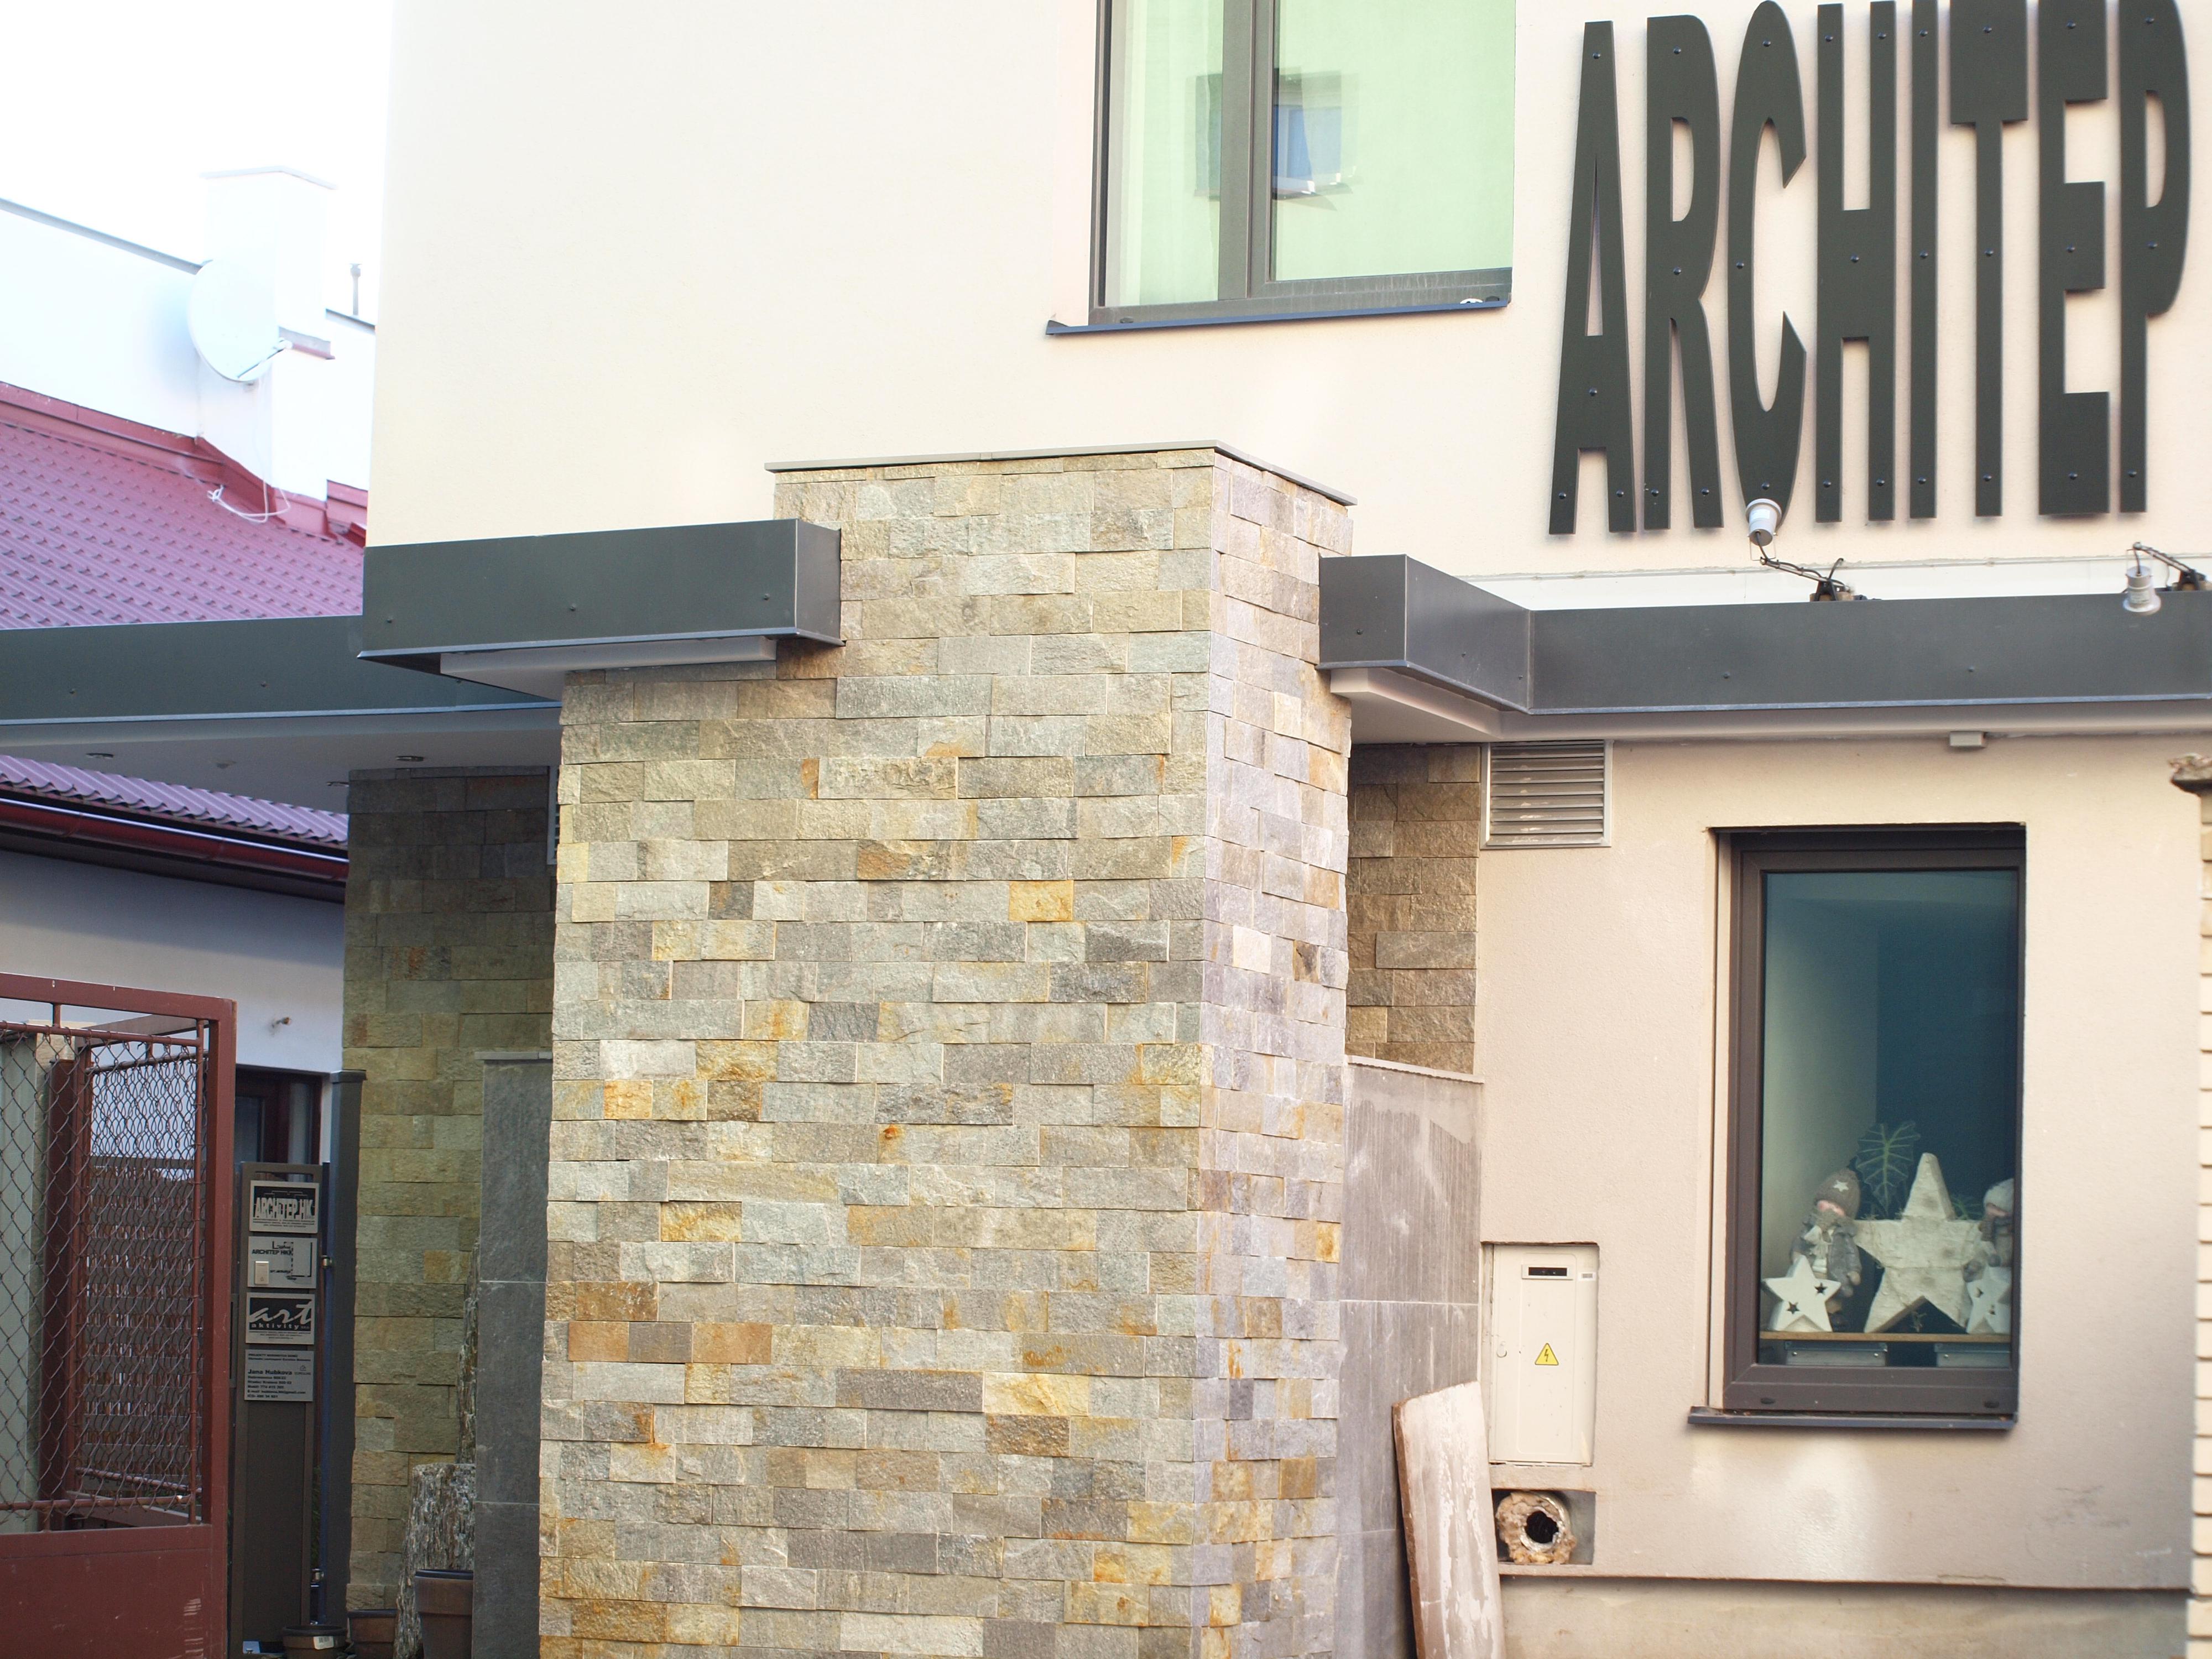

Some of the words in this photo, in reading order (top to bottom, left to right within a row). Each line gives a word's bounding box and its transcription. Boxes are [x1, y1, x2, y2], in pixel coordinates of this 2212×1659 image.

[1549, 0, 2190, 535] ARCHITEP
[254, 1197, 298, 1219] ARCHITEP
[248, 1301, 312, 1325] art
